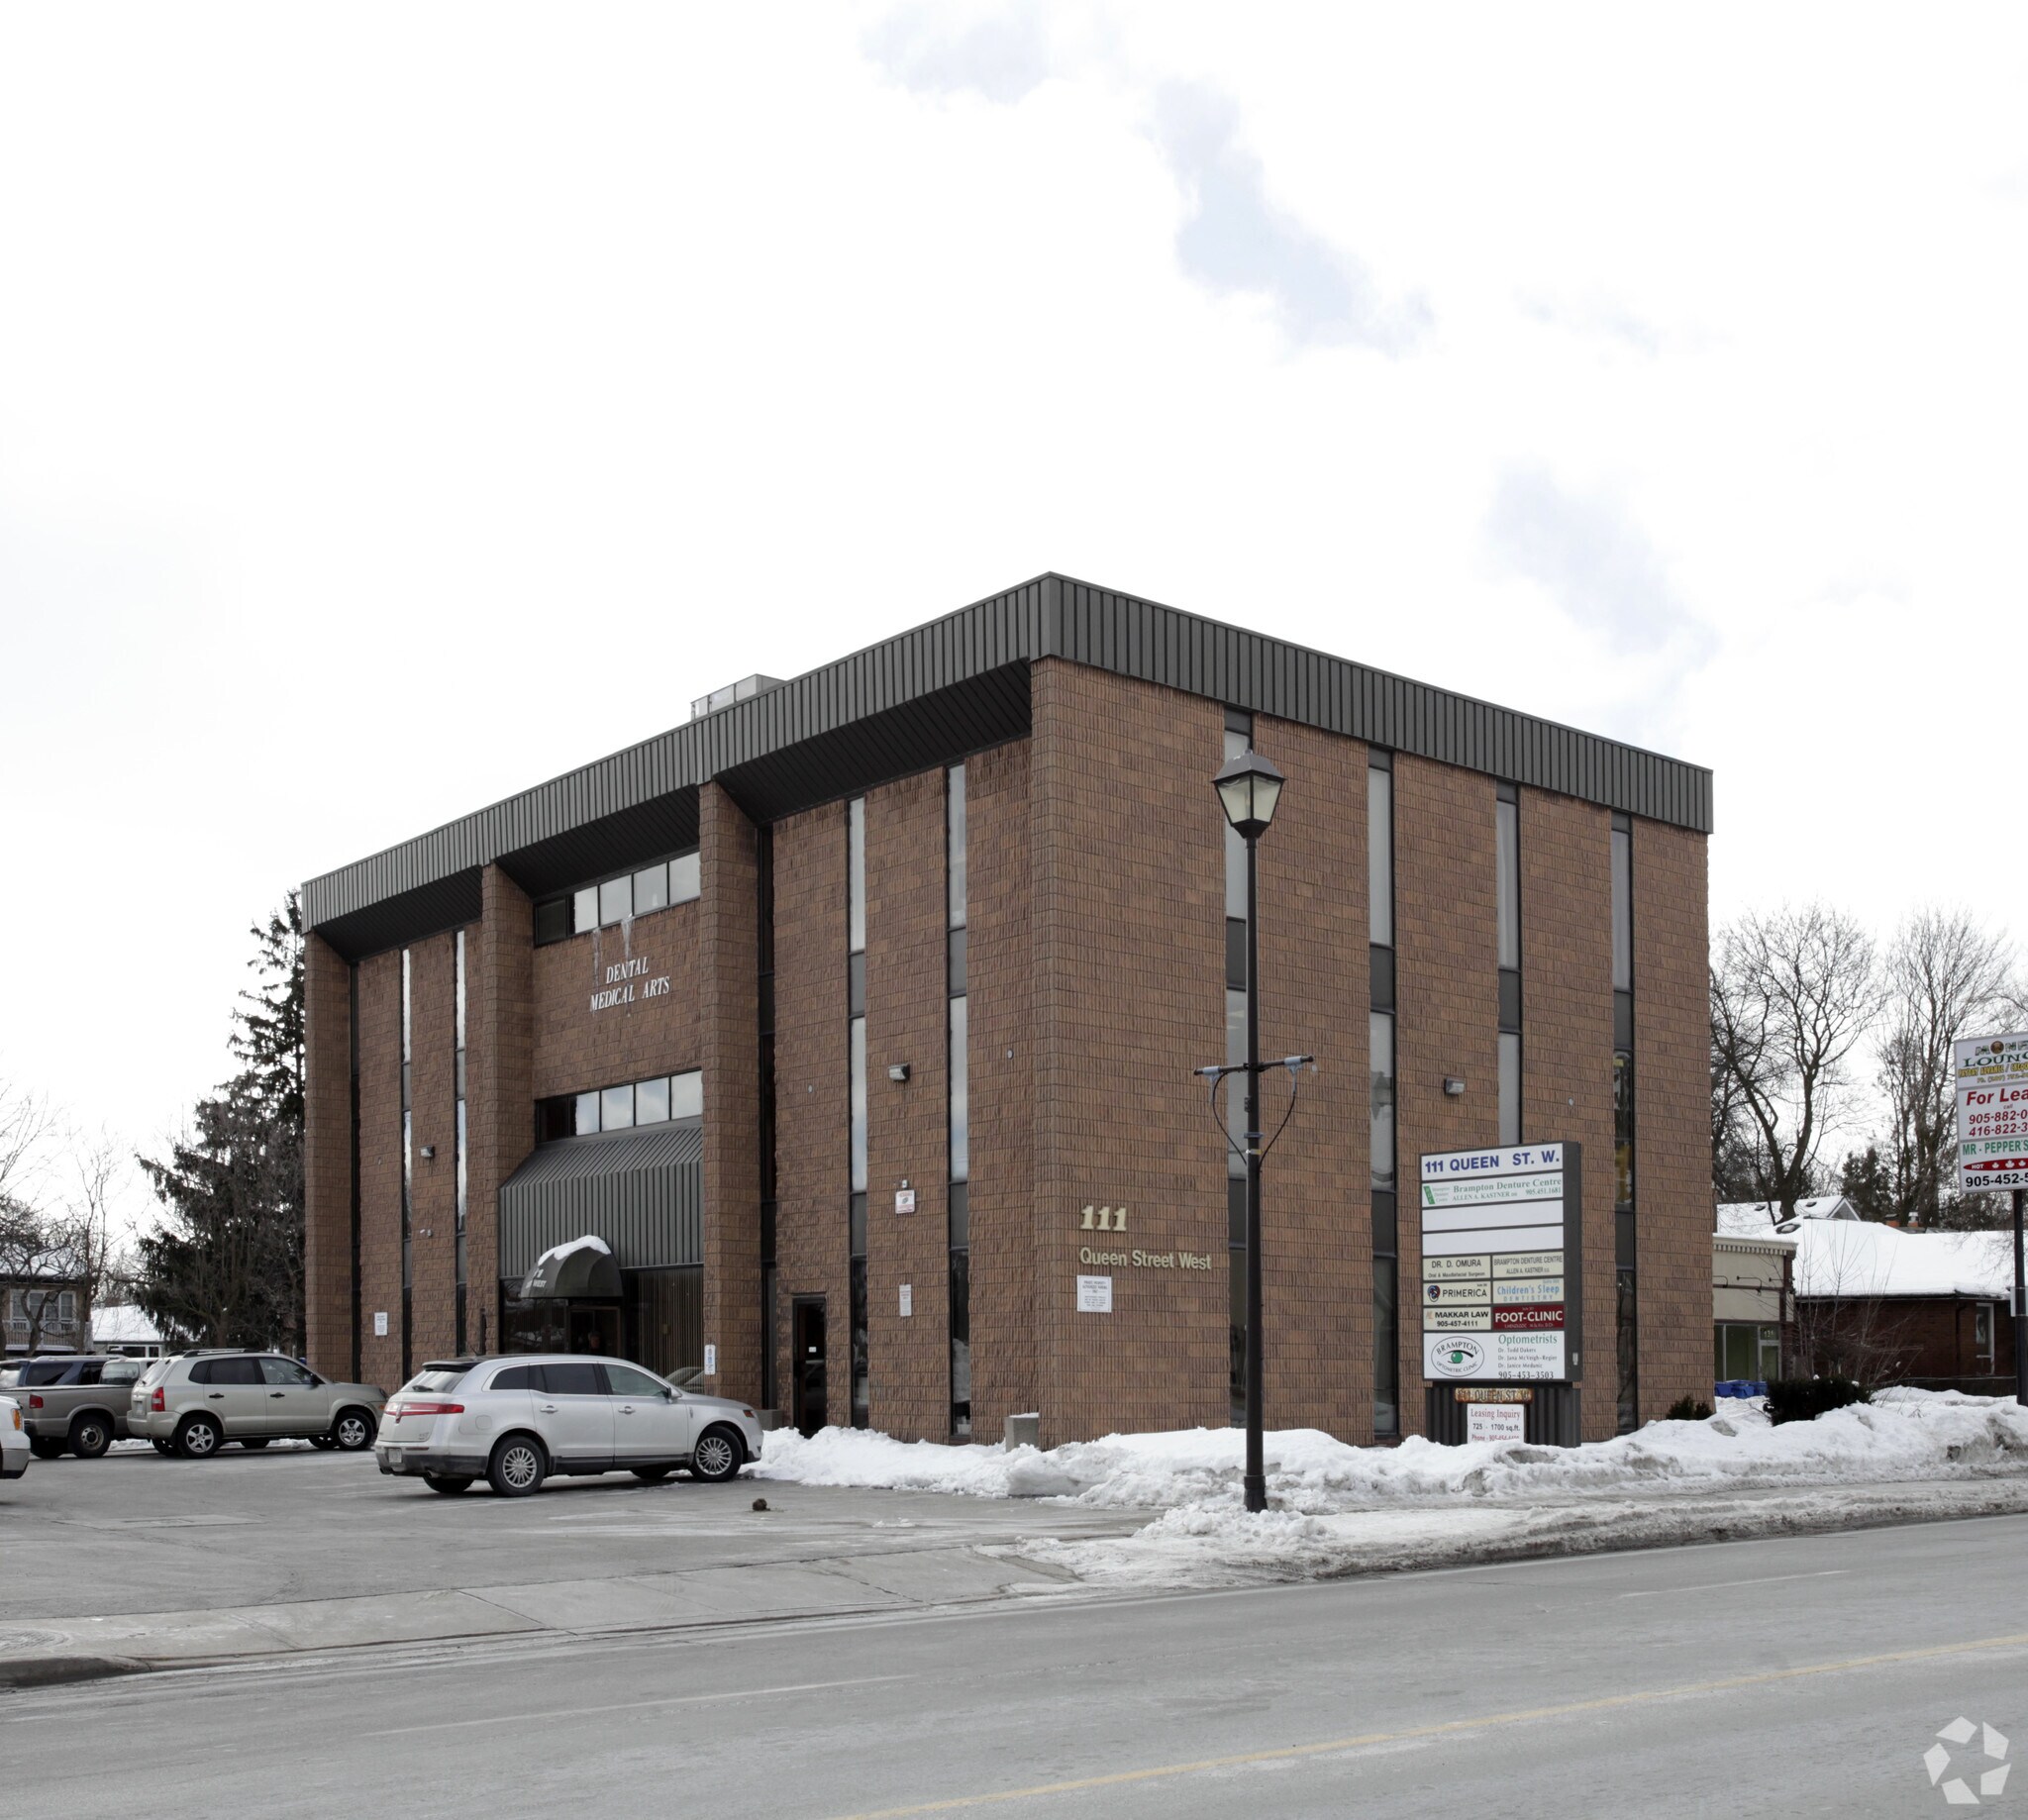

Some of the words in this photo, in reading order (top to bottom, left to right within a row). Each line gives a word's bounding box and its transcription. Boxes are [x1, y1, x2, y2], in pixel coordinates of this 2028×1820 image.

[606, 957, 649, 984] DENTAL
[590, 984, 635, 1012] MEDICAL
[642, 975, 670, 999] ARTS
[1966, 1091, 1994, 1106] For
[1999, 1088, 2028, 1102] Lea
[1969, 1109, 2028, 1125] 905-882-0
[1969, 1122, 2028, 1137] 416-822-3
[1963, 1144, 1977, 1156] MR
[1425, 1161, 1443, 1172] 111
[1450, 1156, 1499, 1170] QUEEN
[1513, 1153, 1534, 1165] ST.
[1541, 1150, 1560, 1163] W.
[1453, 1184, 1494, 1193] Brampton
[1497, 1181, 1530, 1190] Denture
[1532, 1178, 1561, 1187] Centre
[1079, 1205, 1127, 1231] 111
[1080, 1247, 1127, 1266] Queen
[1132, 1249, 1174, 1267] Street
[1178, 1251, 1212, 1269] West
[1455, 1259, 1481, 1267] OMURA
[1442, 1289, 1487, 1297] PRIMERICA
[1497, 1285, 1535, 1295] Children's
[1538, 1284, 1559, 1295] Sleep
[1495, 1311, 1563, 1323] FOOT-CLINIC
[1498, 1333, 1557, 1347] Optometrists
[1436, 1341, 1479, 1355] BRAMPTON
[1463, 1362, 1477, 1372] CLINIC
[1475, 1390, 1503, 1402] QUEEN
[1471, 1409, 1495, 1420] Leasing
[1497, 1409, 1520, 1420] Inquiry
